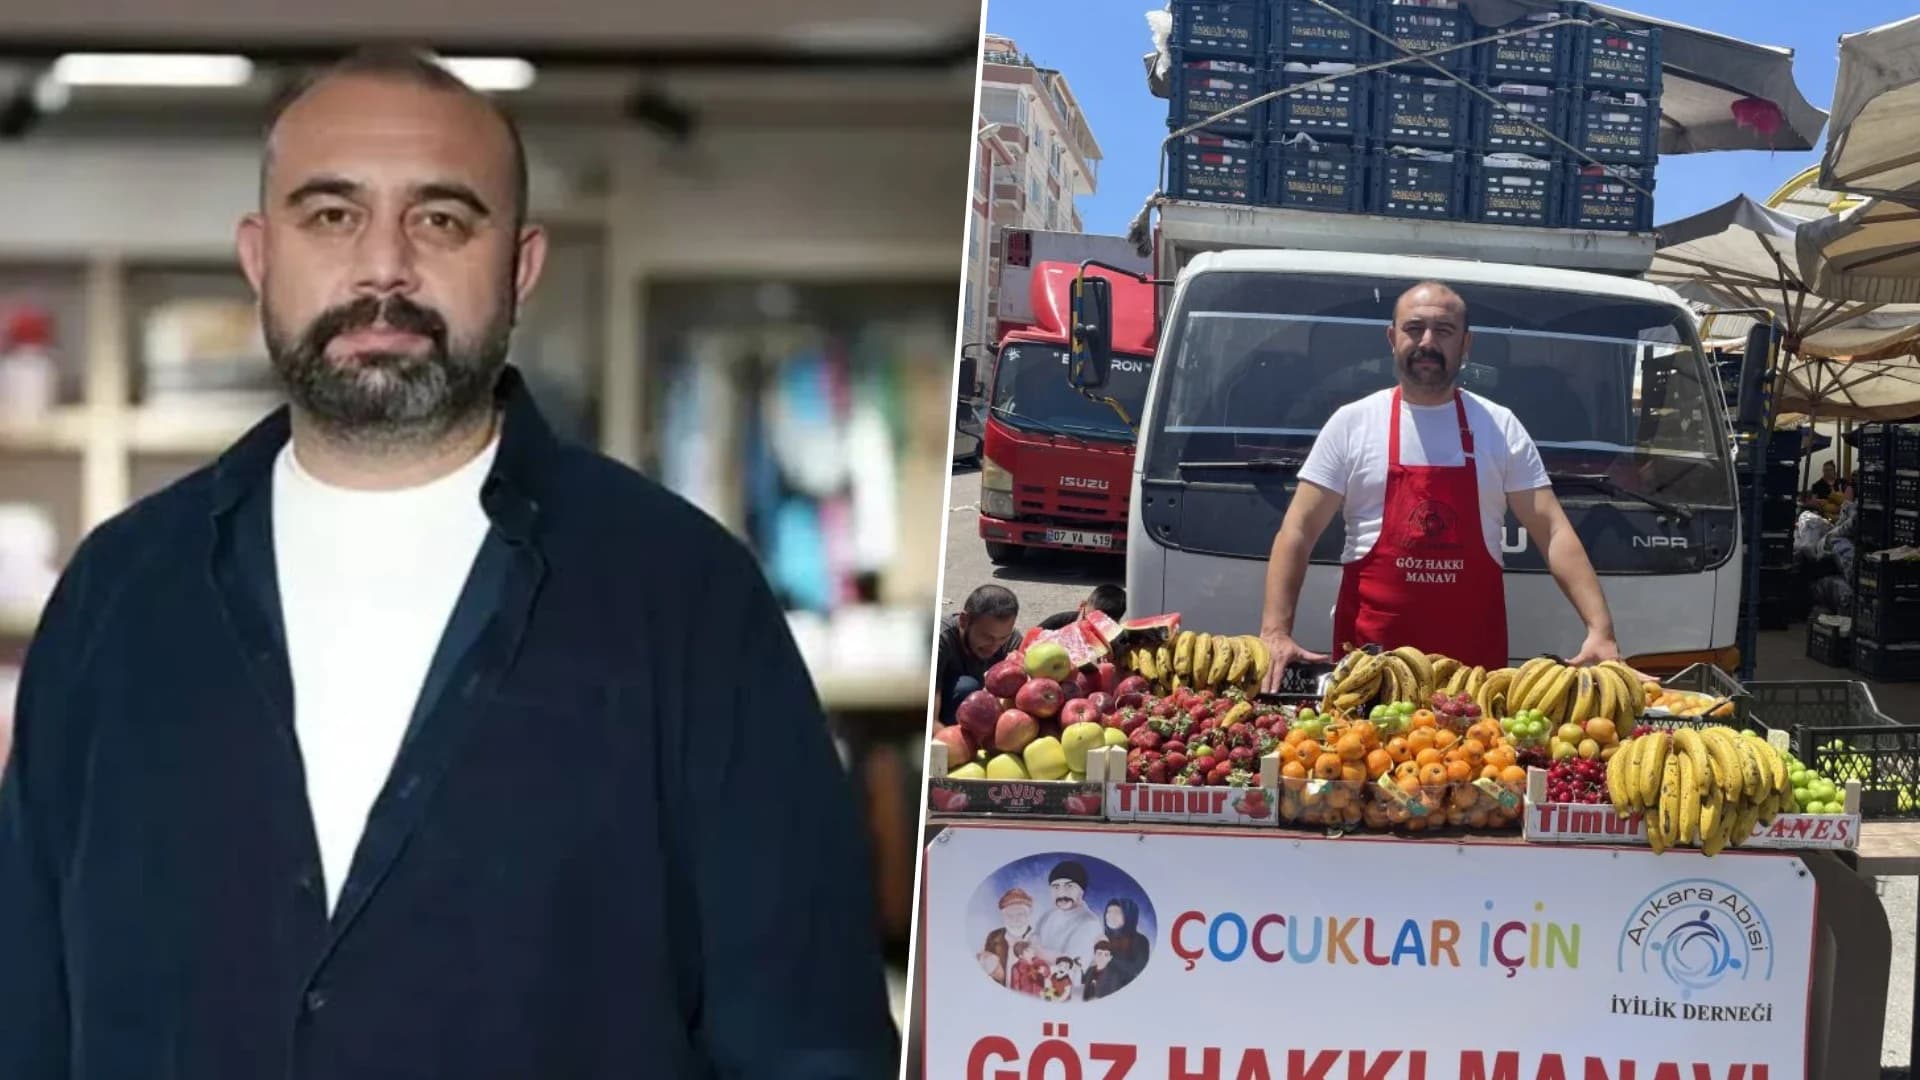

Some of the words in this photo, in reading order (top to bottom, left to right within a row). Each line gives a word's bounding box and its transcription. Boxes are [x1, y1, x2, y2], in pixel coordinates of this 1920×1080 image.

[1060, 475, 1110, 490] ISUZU
[1054, 531, 1067, 542] 07
[1092, 533, 1112, 546] 419
[1632, 535, 1689, 549] NPR
[1395, 556, 1424, 570] GÖZ
[1425, 559, 1465, 570] HAKKI
[1405, 571, 1457, 583] MANAVI
[1115, 783, 1232, 815] Timur
[1627, 887, 1714, 947] Ankara
[1719, 893, 1769, 952] Abisi
[1170, 910, 1461, 971] ÇOCUKLAR
[1479, 900, 1581, 978] İÇİN
[1611, 993, 1677, 1019] İYİLİK
[1683, 1002, 1774, 1022] DERNEĞİ
